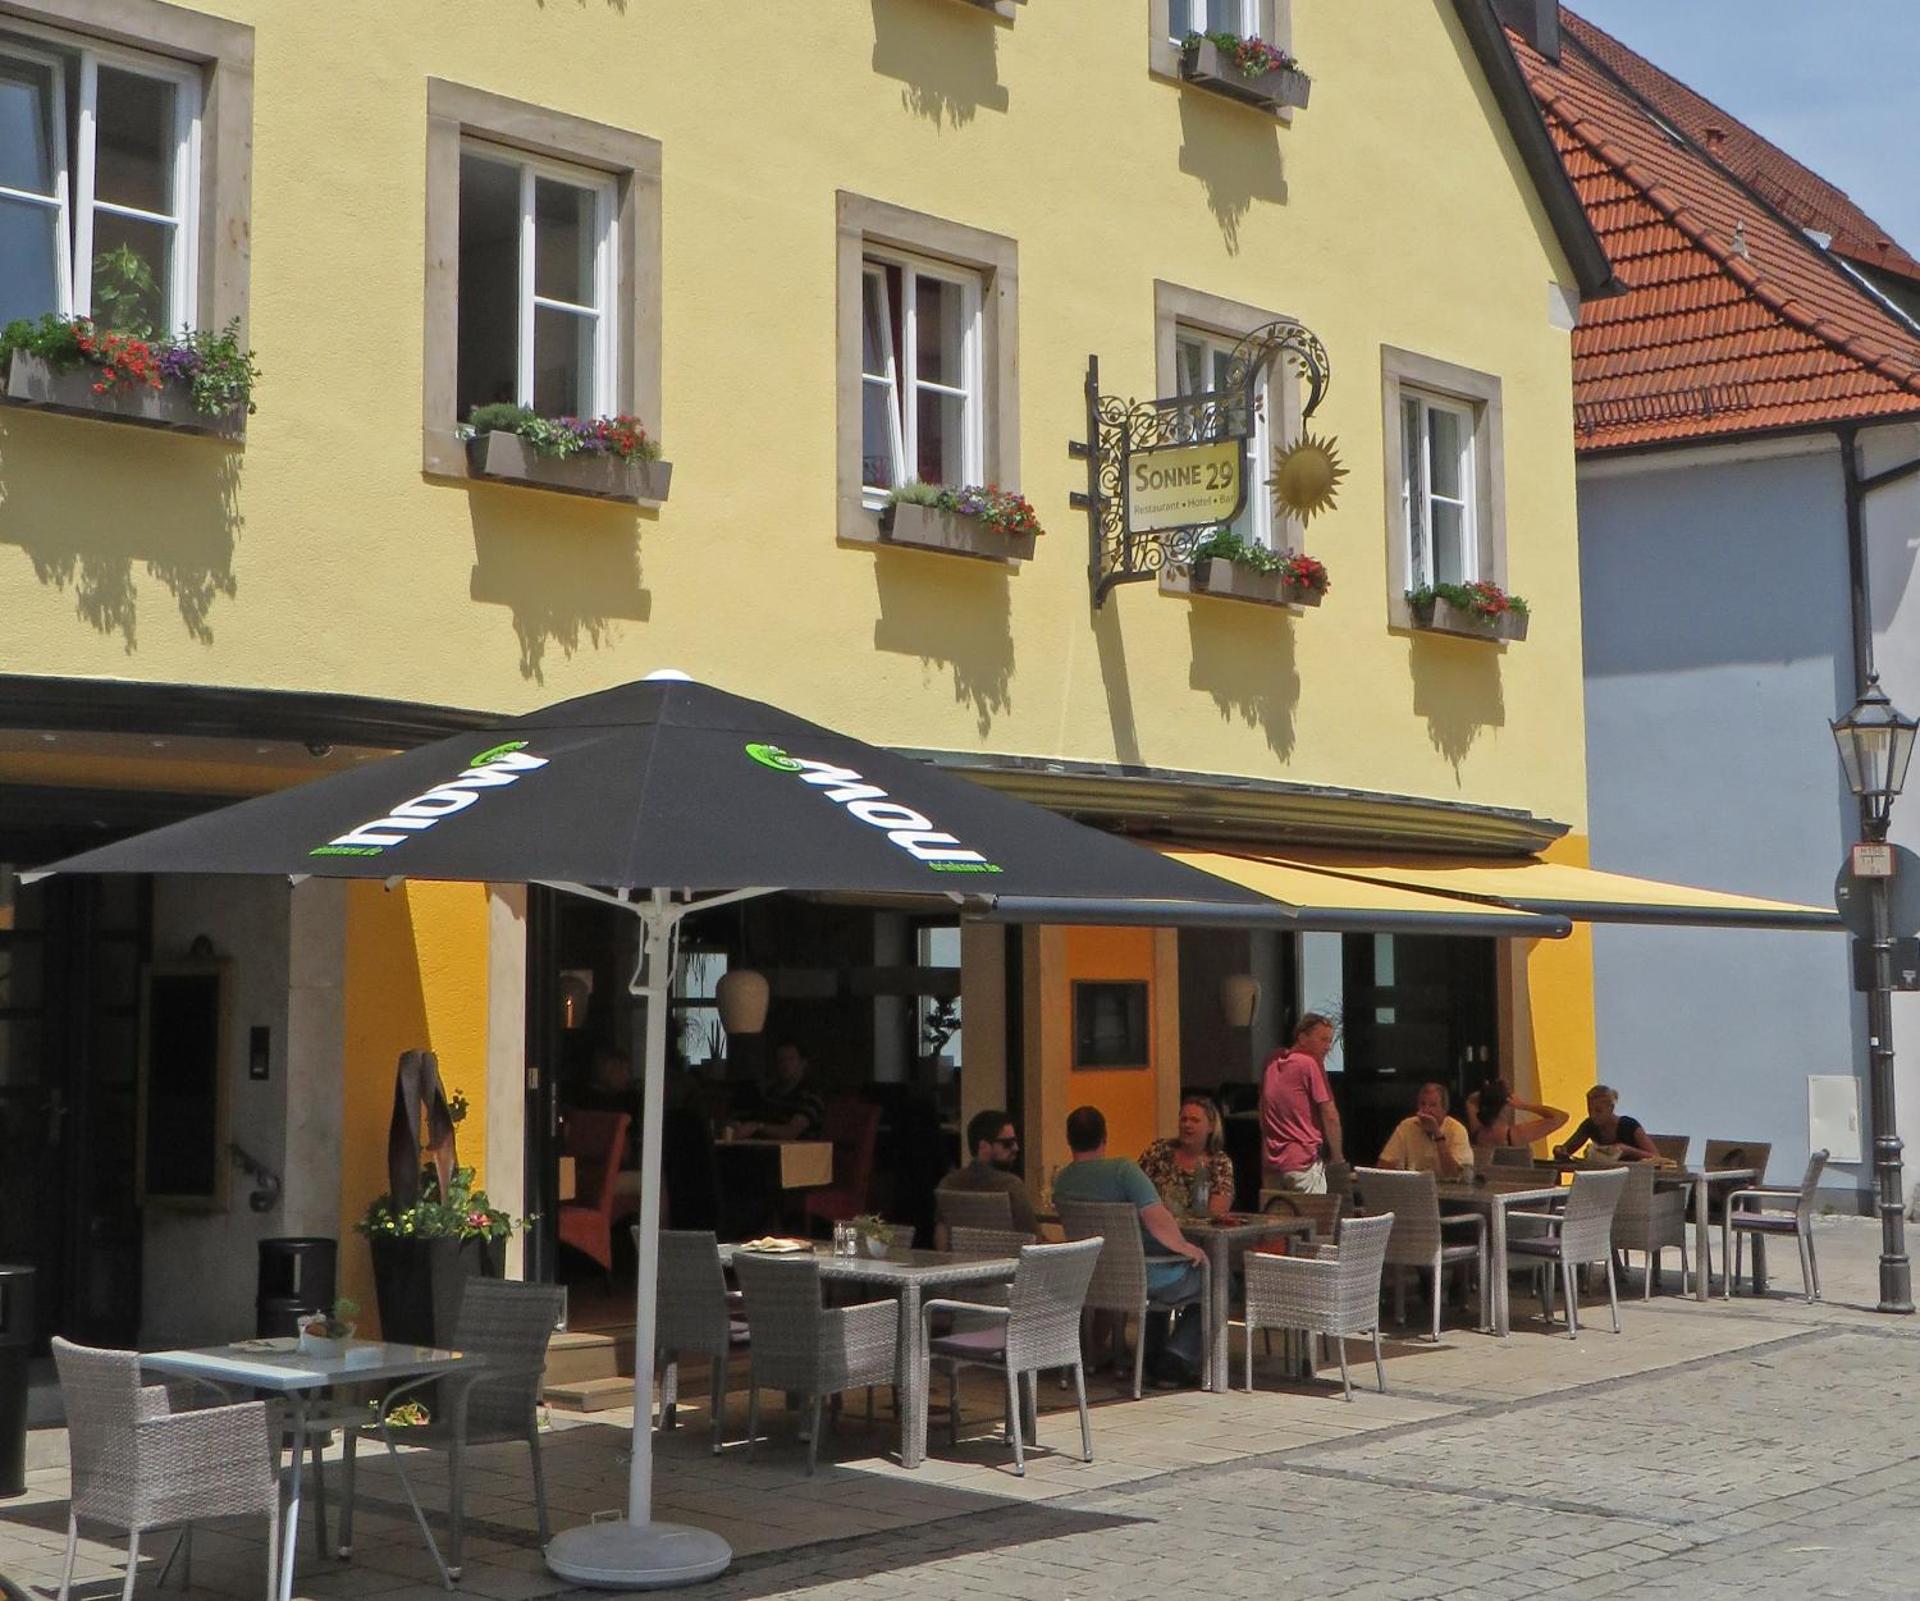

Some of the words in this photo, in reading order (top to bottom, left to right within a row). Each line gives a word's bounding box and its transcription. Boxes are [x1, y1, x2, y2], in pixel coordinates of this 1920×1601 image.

[1135, 463, 1201, 492] SONNE
[1206, 461, 1233, 490] 29
[1134, 501, 1179, 516] Restaurant
[1187, 495, 1211, 509] Hotel
